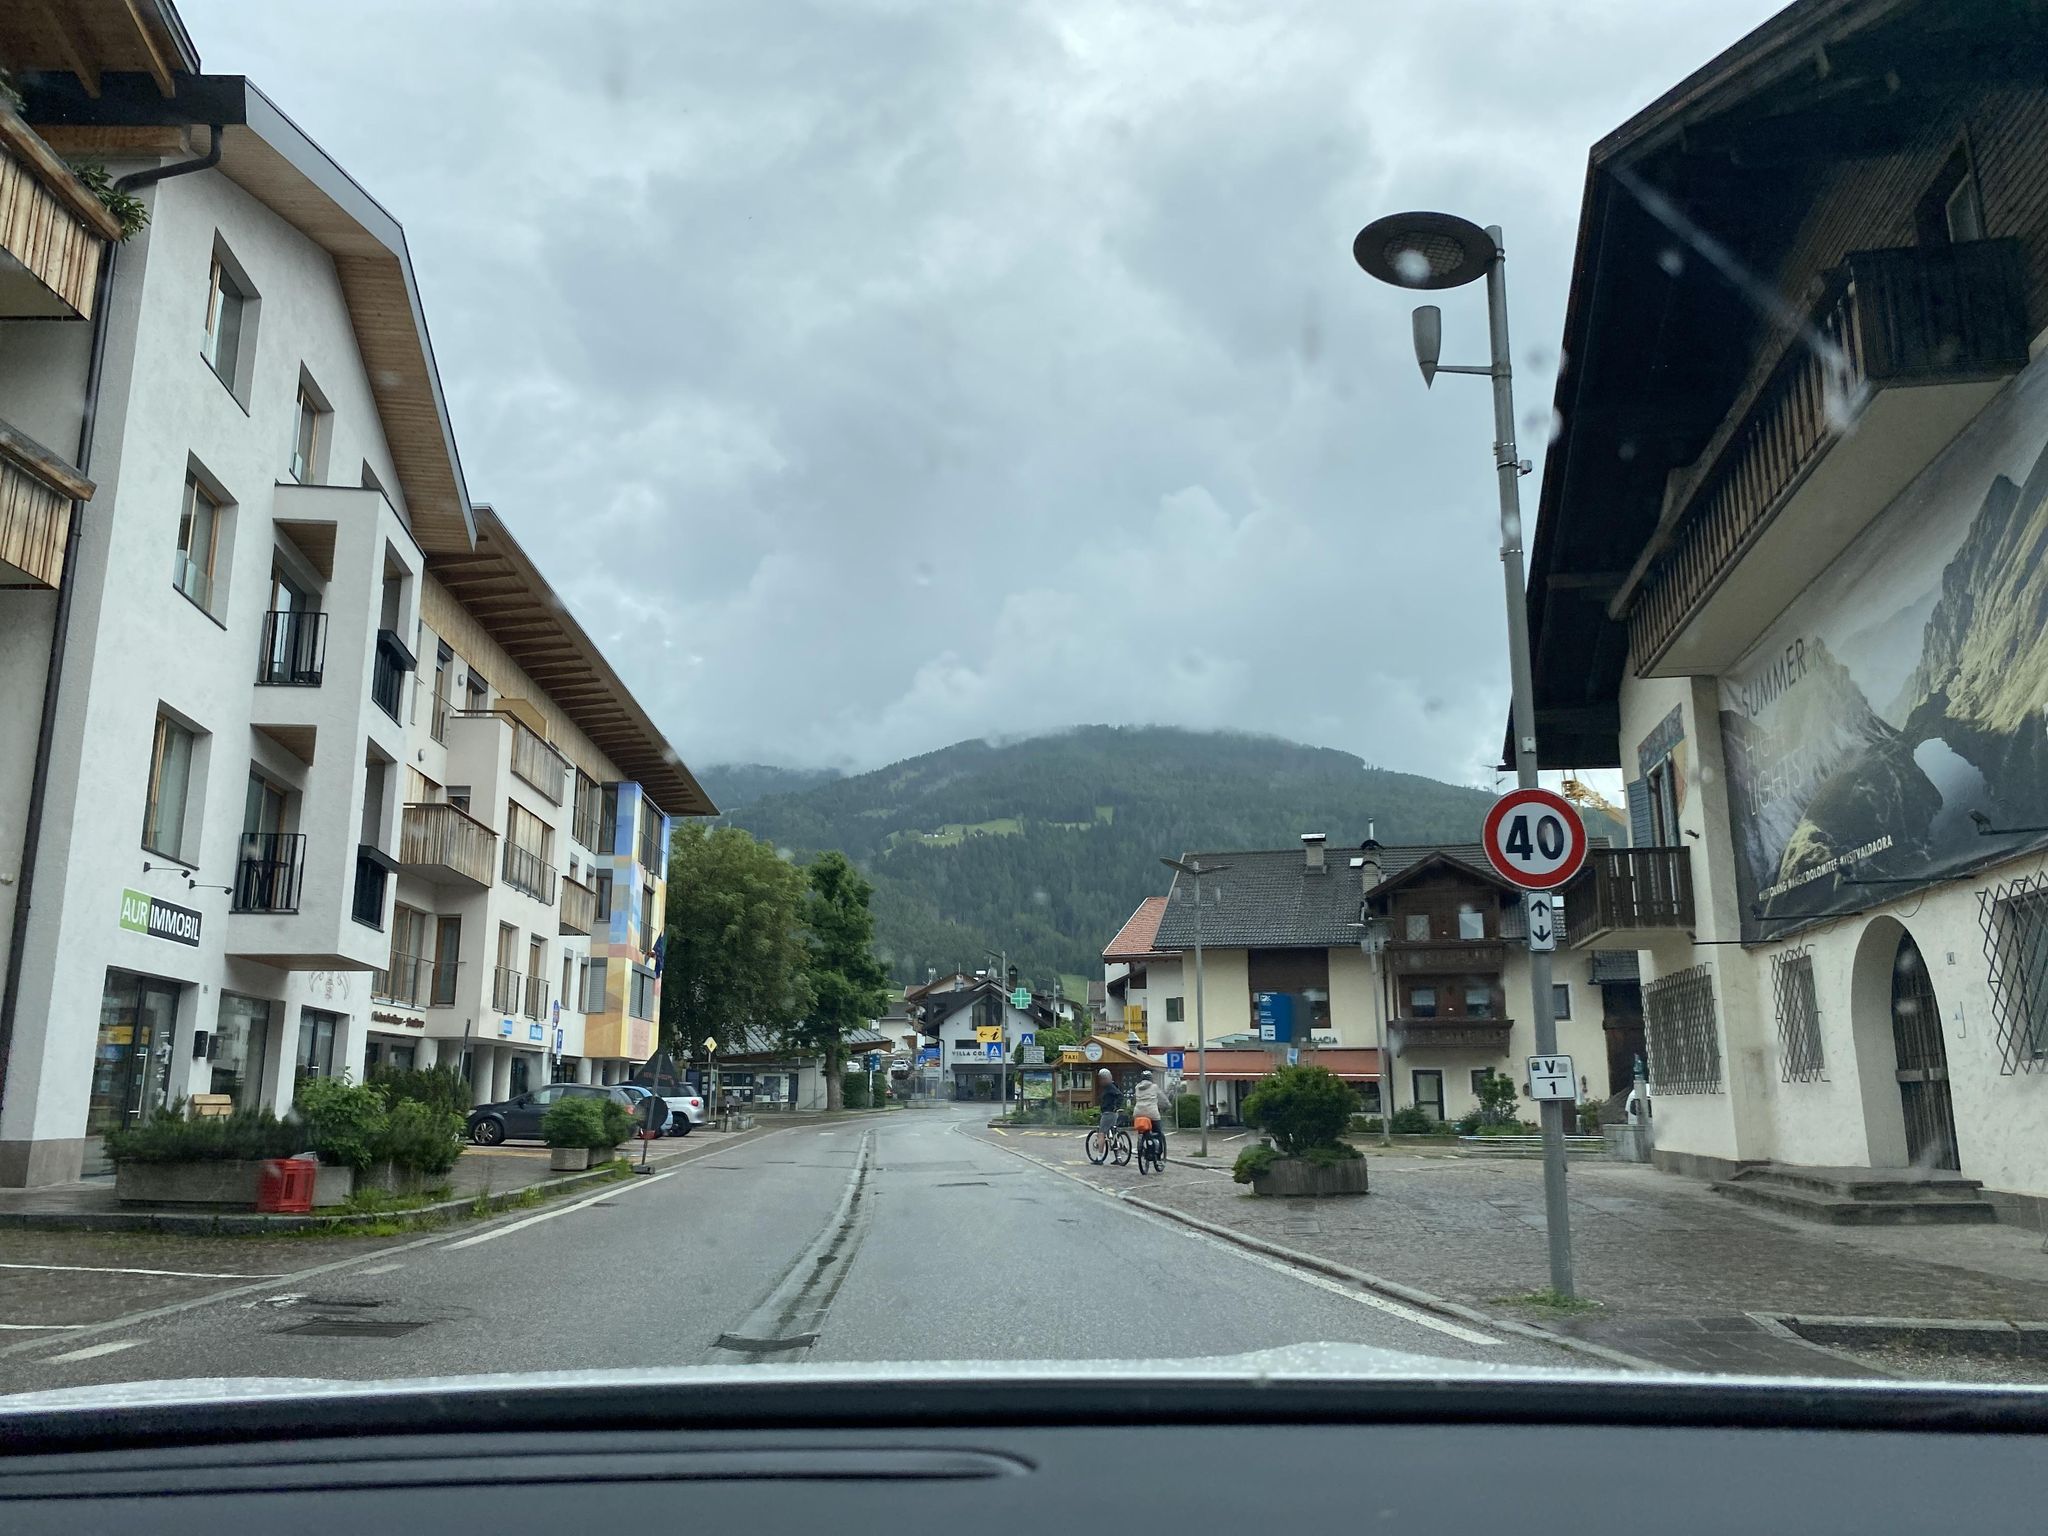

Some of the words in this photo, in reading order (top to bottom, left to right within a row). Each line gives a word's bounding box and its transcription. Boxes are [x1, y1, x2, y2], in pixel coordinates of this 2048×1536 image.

[1742, 638, 1807, 719] SUMMER
[1505, 815, 1564, 861] 40
[1170, 1053, 1180, 1067] P
[1544, 1059, 1556, 1075] V
[1549, 1080, 1557, 1096] 1
